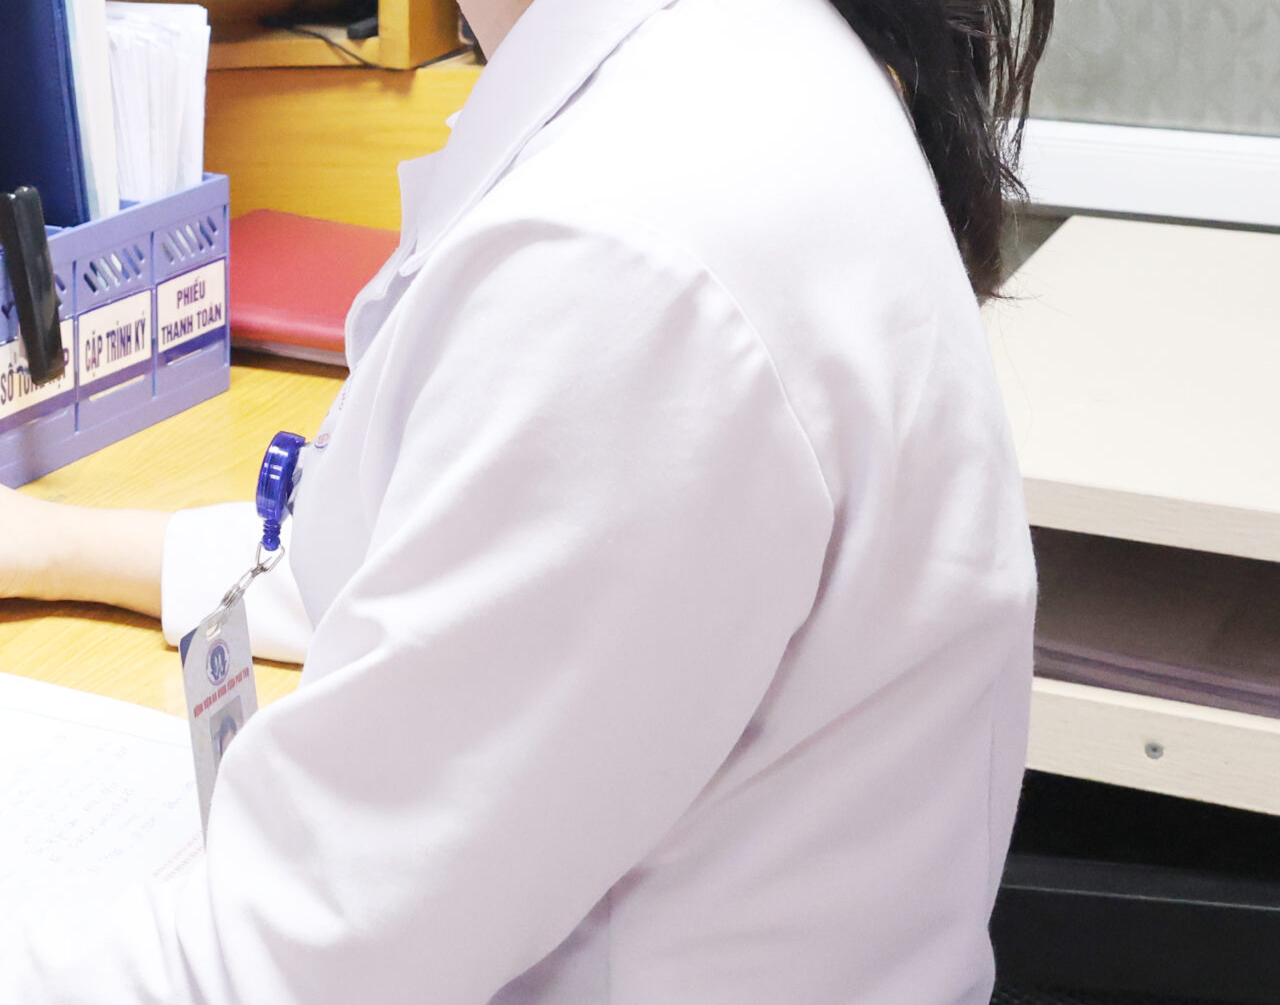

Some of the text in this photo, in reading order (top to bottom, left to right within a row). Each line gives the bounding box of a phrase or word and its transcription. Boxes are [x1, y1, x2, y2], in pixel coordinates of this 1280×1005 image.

[177, 275, 206, 309] PHIẾU
[106, 320, 132, 364] TRÌNH
[135, 310, 146, 352] KÝ
[161, 302, 222, 346] THANH TOÁN
